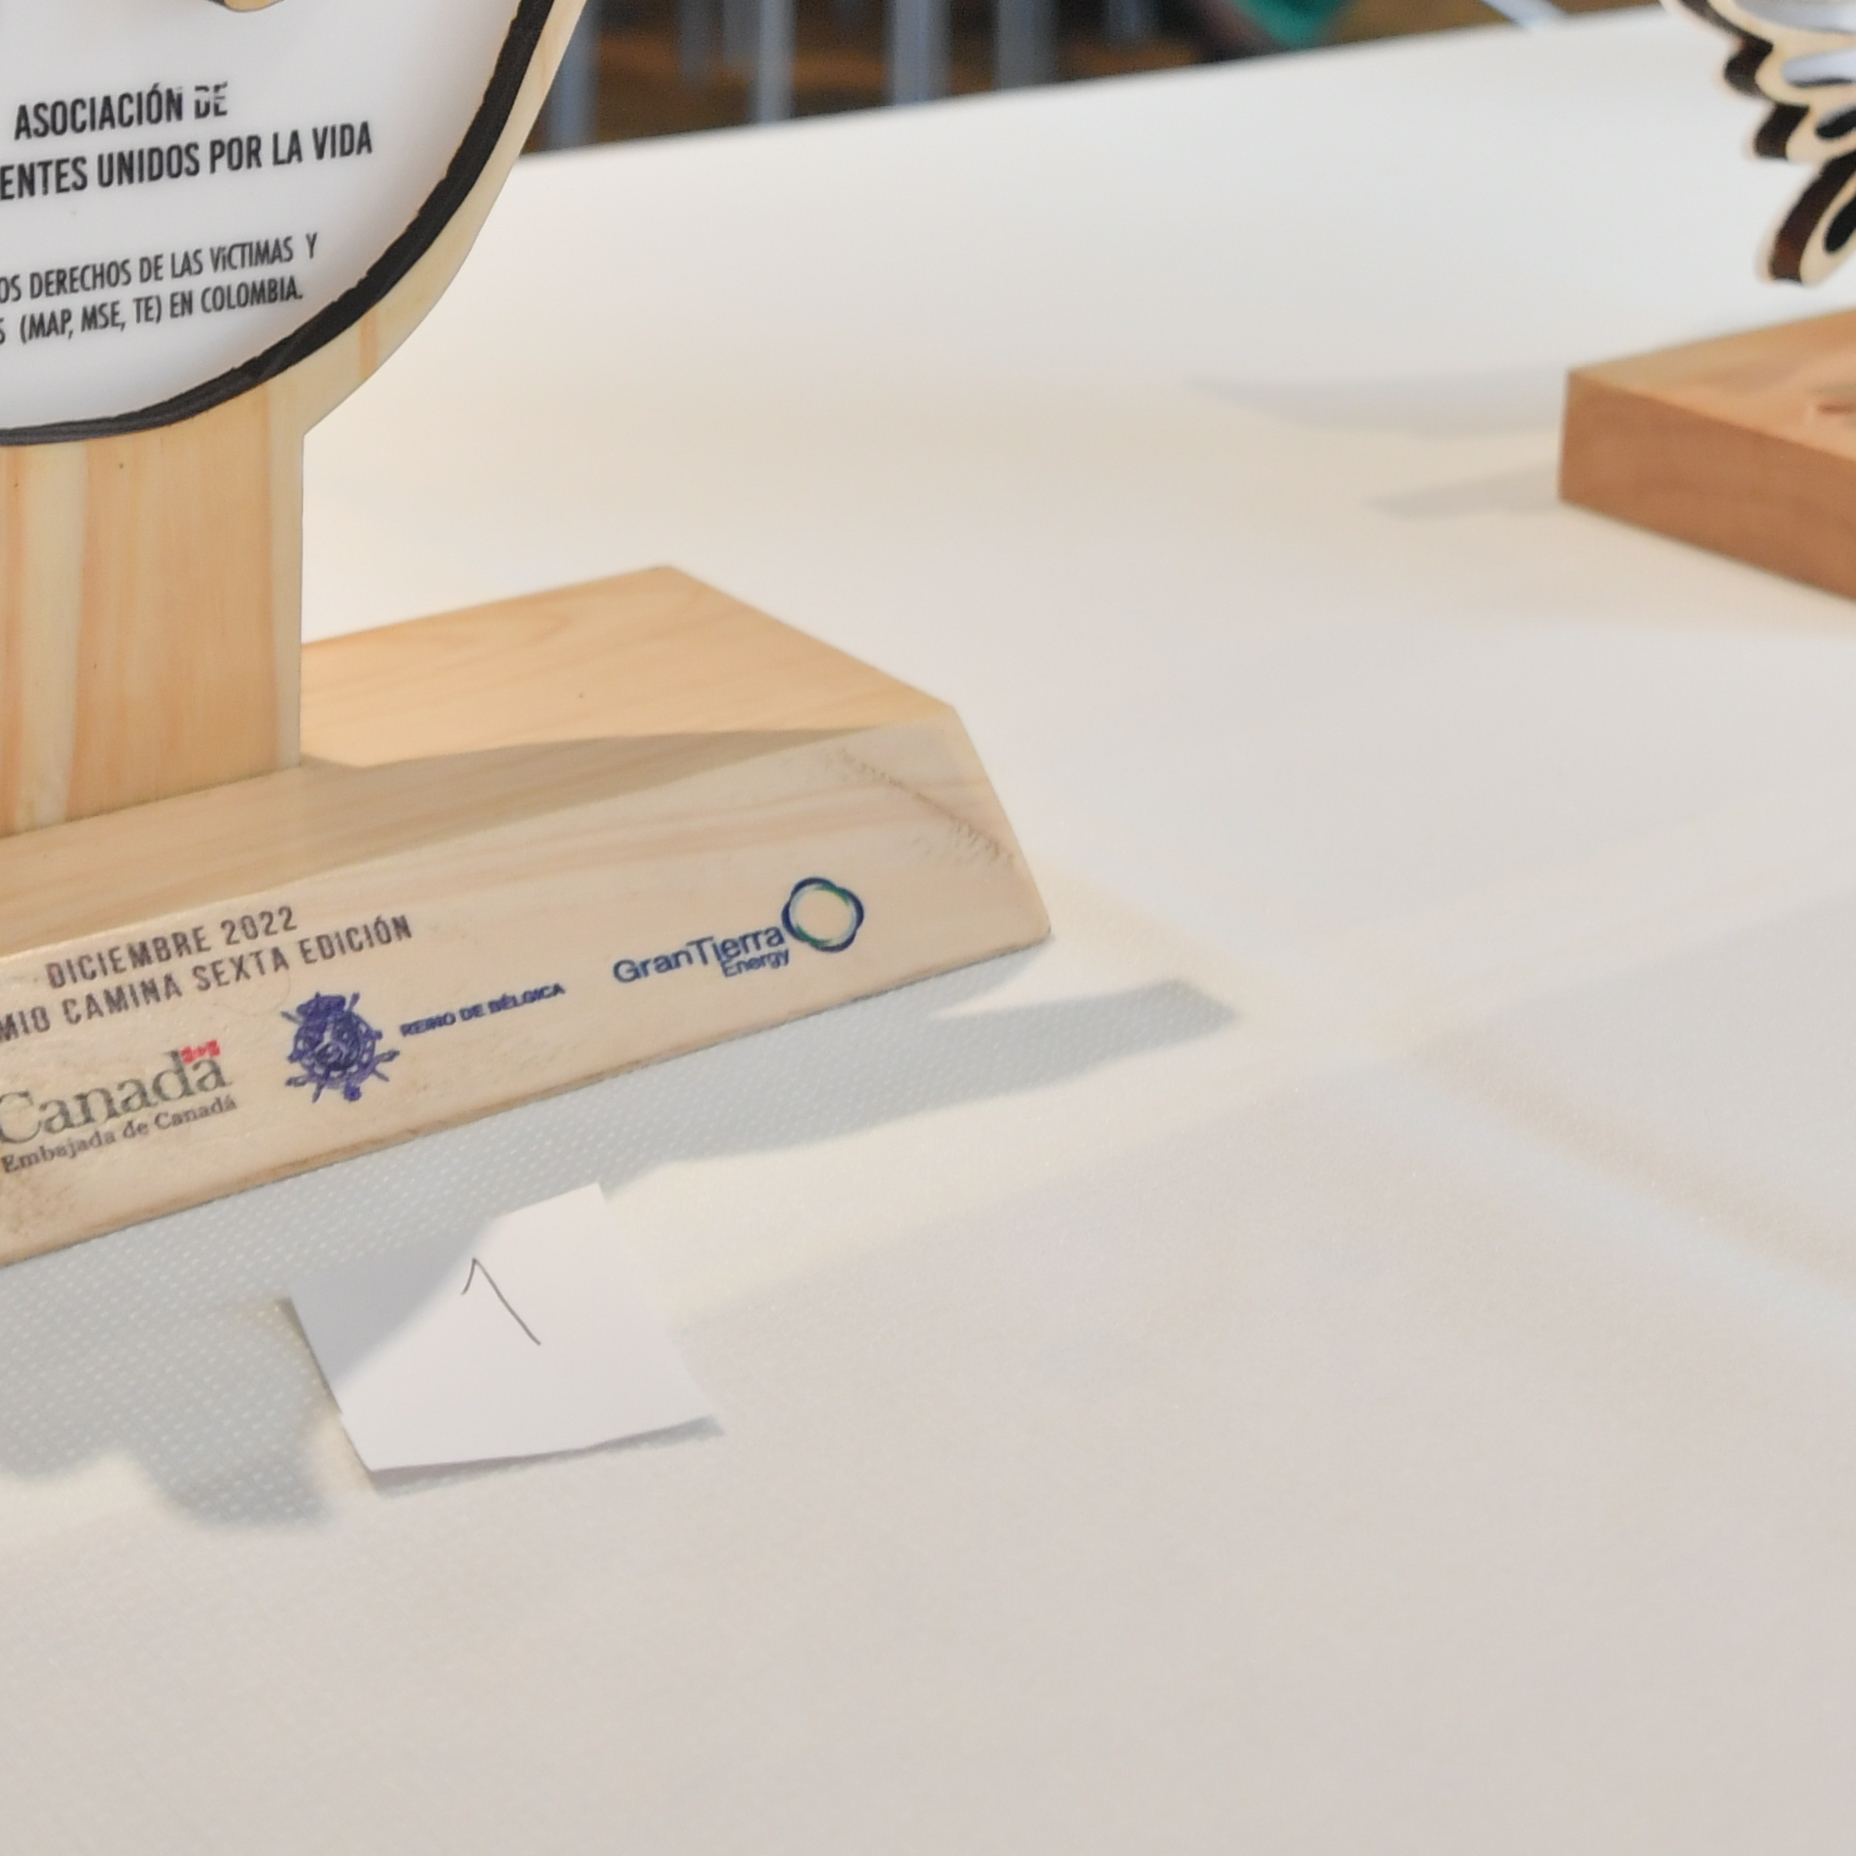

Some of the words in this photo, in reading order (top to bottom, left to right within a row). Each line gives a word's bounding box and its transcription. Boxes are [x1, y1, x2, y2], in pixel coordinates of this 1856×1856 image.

[14, 83, 183, 141] ASOCIACIÓN
[194, 82, 229, 119] DE
[97, 142, 201, 188] UNIDOS
[209, 134, 263, 175] POR
[273, 130, 303, 166] LA
[313, 121, 373, 160] VIDA
[30, 259, 131, 299] DERECHOS
[139, 254, 164, 284] DE
[171, 249, 203, 278] LAS
[305, 232, 318, 259] Y
[19, 310, 73, 346] (MAP,
[80, 300, 126, 332] MSE,
[133, 295, 162, 324] TE)
[170, 290, 193, 318] EN
[200, 275, 303, 314] COLOMBIA.
[46, 924, 212, 989] DICIEMBRE
[221, 906, 297, 946] 2022
[63, 971, 182, 1024] CAMINA
[193, 947, 289, 992] SEXTA
[298, 913, 412, 966] EDICIÓN
[722, 947, 790, 978] Energy
[400, 1012, 456, 1037] REINO
[460, 1003, 485, 1021] DE
[1, 1125, 116, 1174] Embajada
[122, 1117, 150, 1139] de
